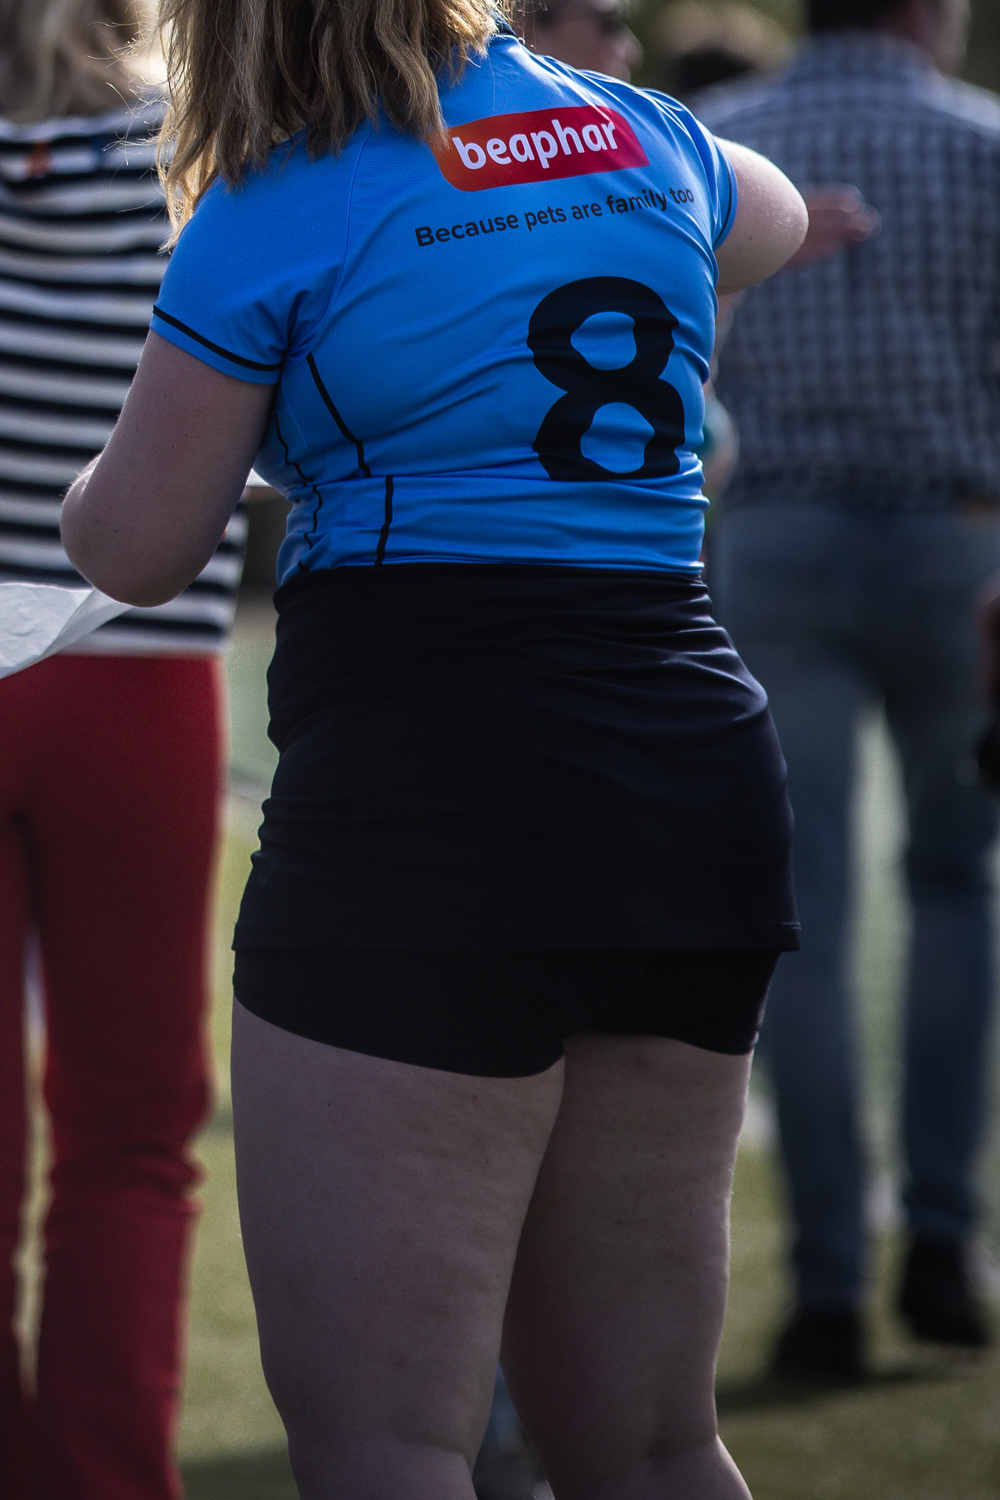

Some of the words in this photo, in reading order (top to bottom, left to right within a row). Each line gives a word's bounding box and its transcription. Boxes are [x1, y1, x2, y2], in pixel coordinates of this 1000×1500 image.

[452, 118, 617, 170] beaphar
[414, 214, 520, 247] Because
[523, 205, 567, 232] pets
[570, 202, 603, 220] are
[605, 188, 667, 215] family
[669, 187, 695, 204] too
[526, 275, 686, 482] 8
